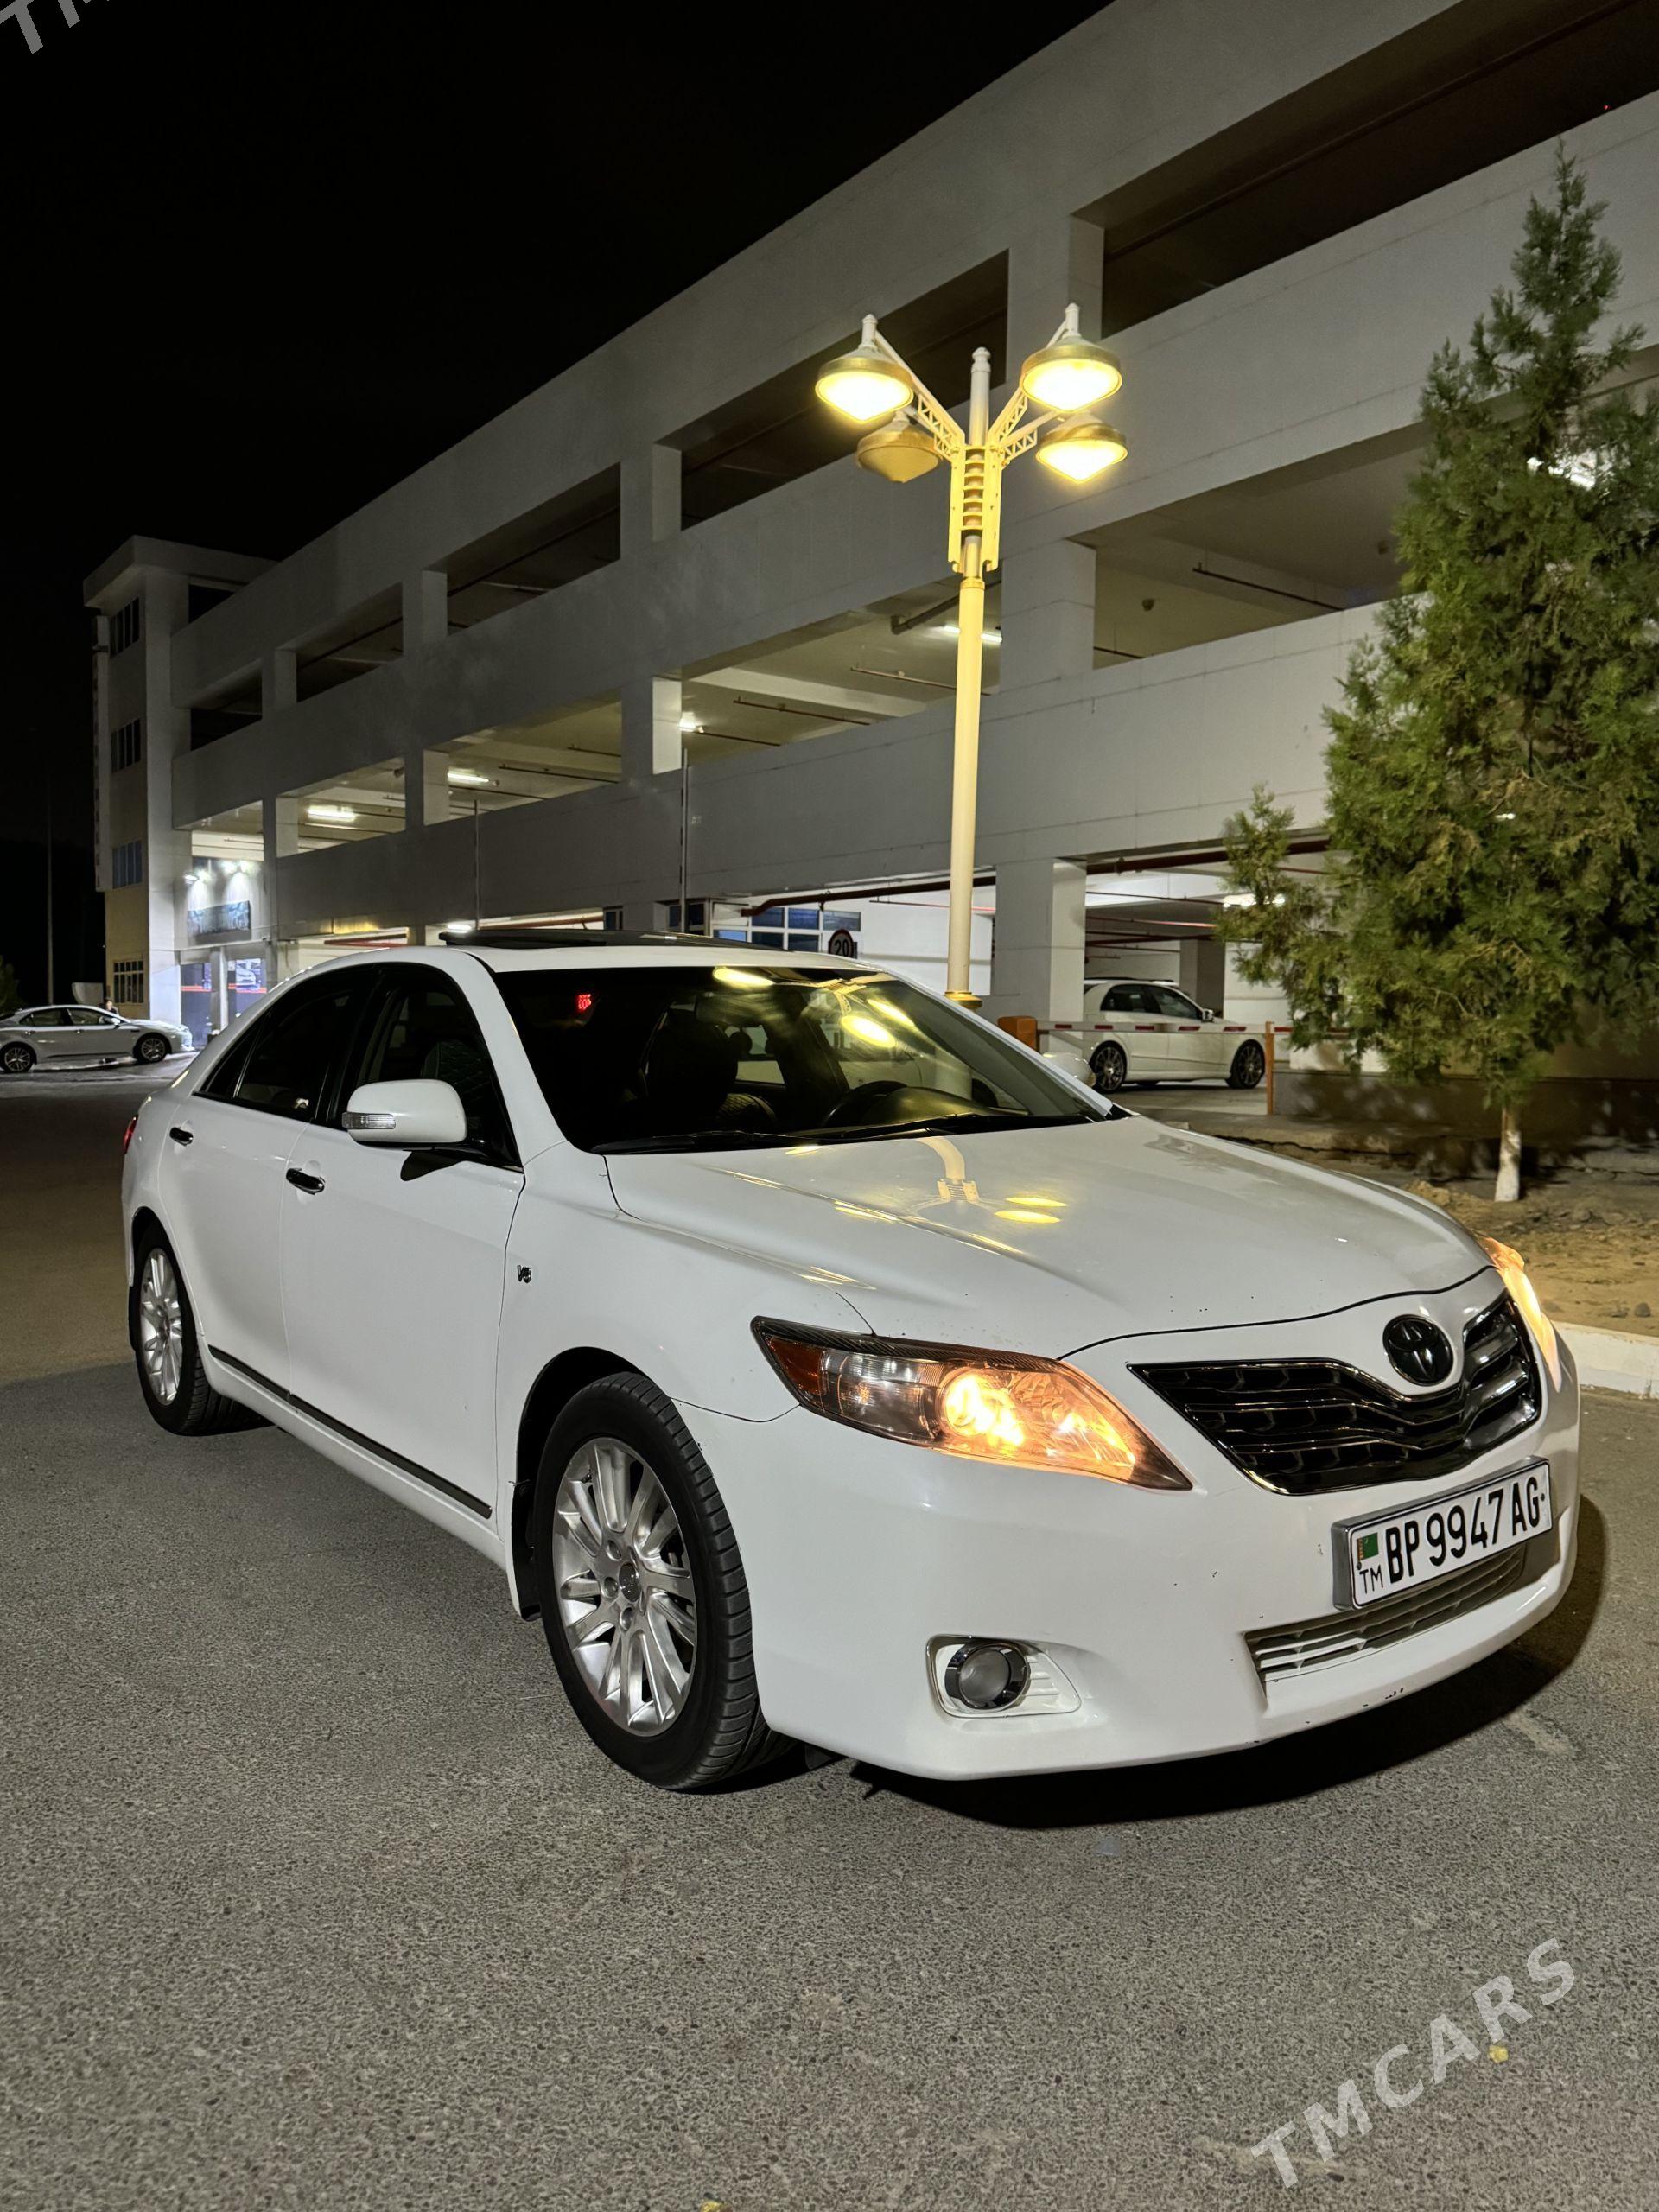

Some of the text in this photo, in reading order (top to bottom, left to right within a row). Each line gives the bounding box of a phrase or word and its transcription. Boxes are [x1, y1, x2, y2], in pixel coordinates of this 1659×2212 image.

[834, 939, 849, 957] 20
[1426, 1488, 1504, 1567] 9947
[1511, 1476, 1541, 1536] AG
[1359, 1564, 1383, 1594] TM
